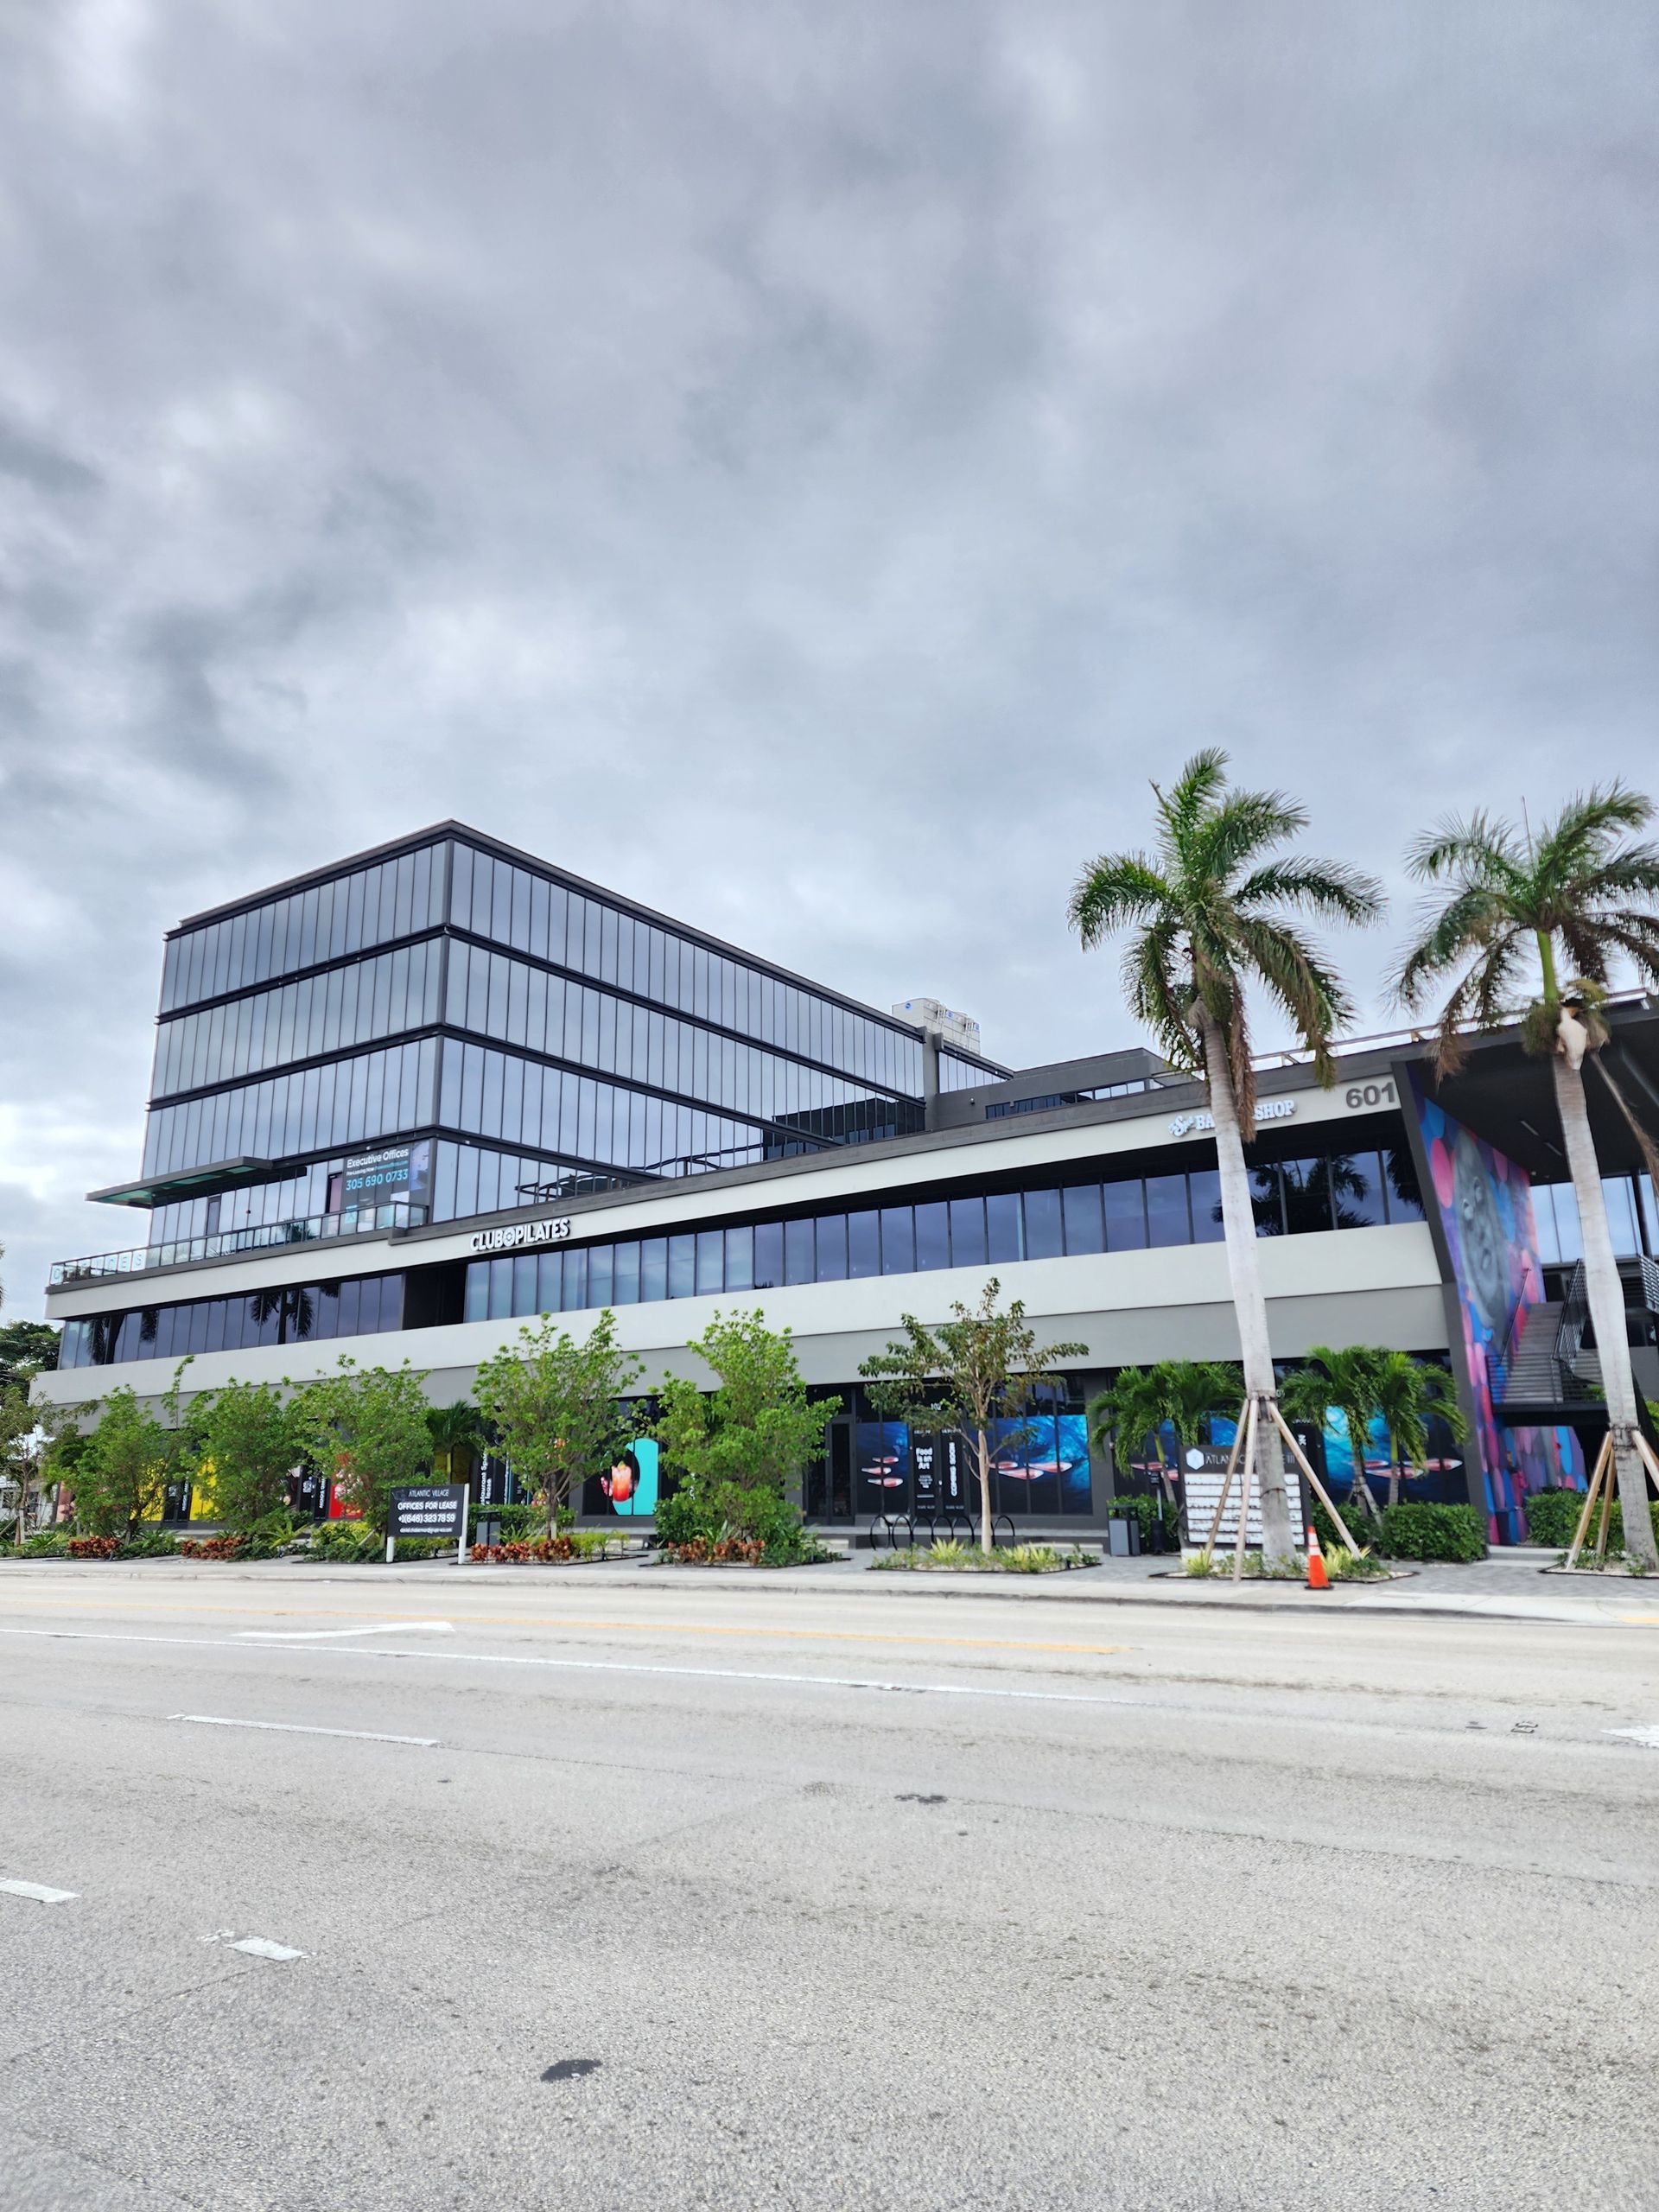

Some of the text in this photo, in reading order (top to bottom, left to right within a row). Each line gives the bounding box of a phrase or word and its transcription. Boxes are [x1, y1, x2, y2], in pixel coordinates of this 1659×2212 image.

[1345, 1082, 1395, 1109] 601
[346, 1154, 382, 1169] Executive
[383, 1148, 410, 1161] Offices
[346, 1169, 409, 1191] 305 690 0733
[916, 1447, 932, 1456] Food
[397, 1500, 458, 1510] OFFICES FOR LEASE
